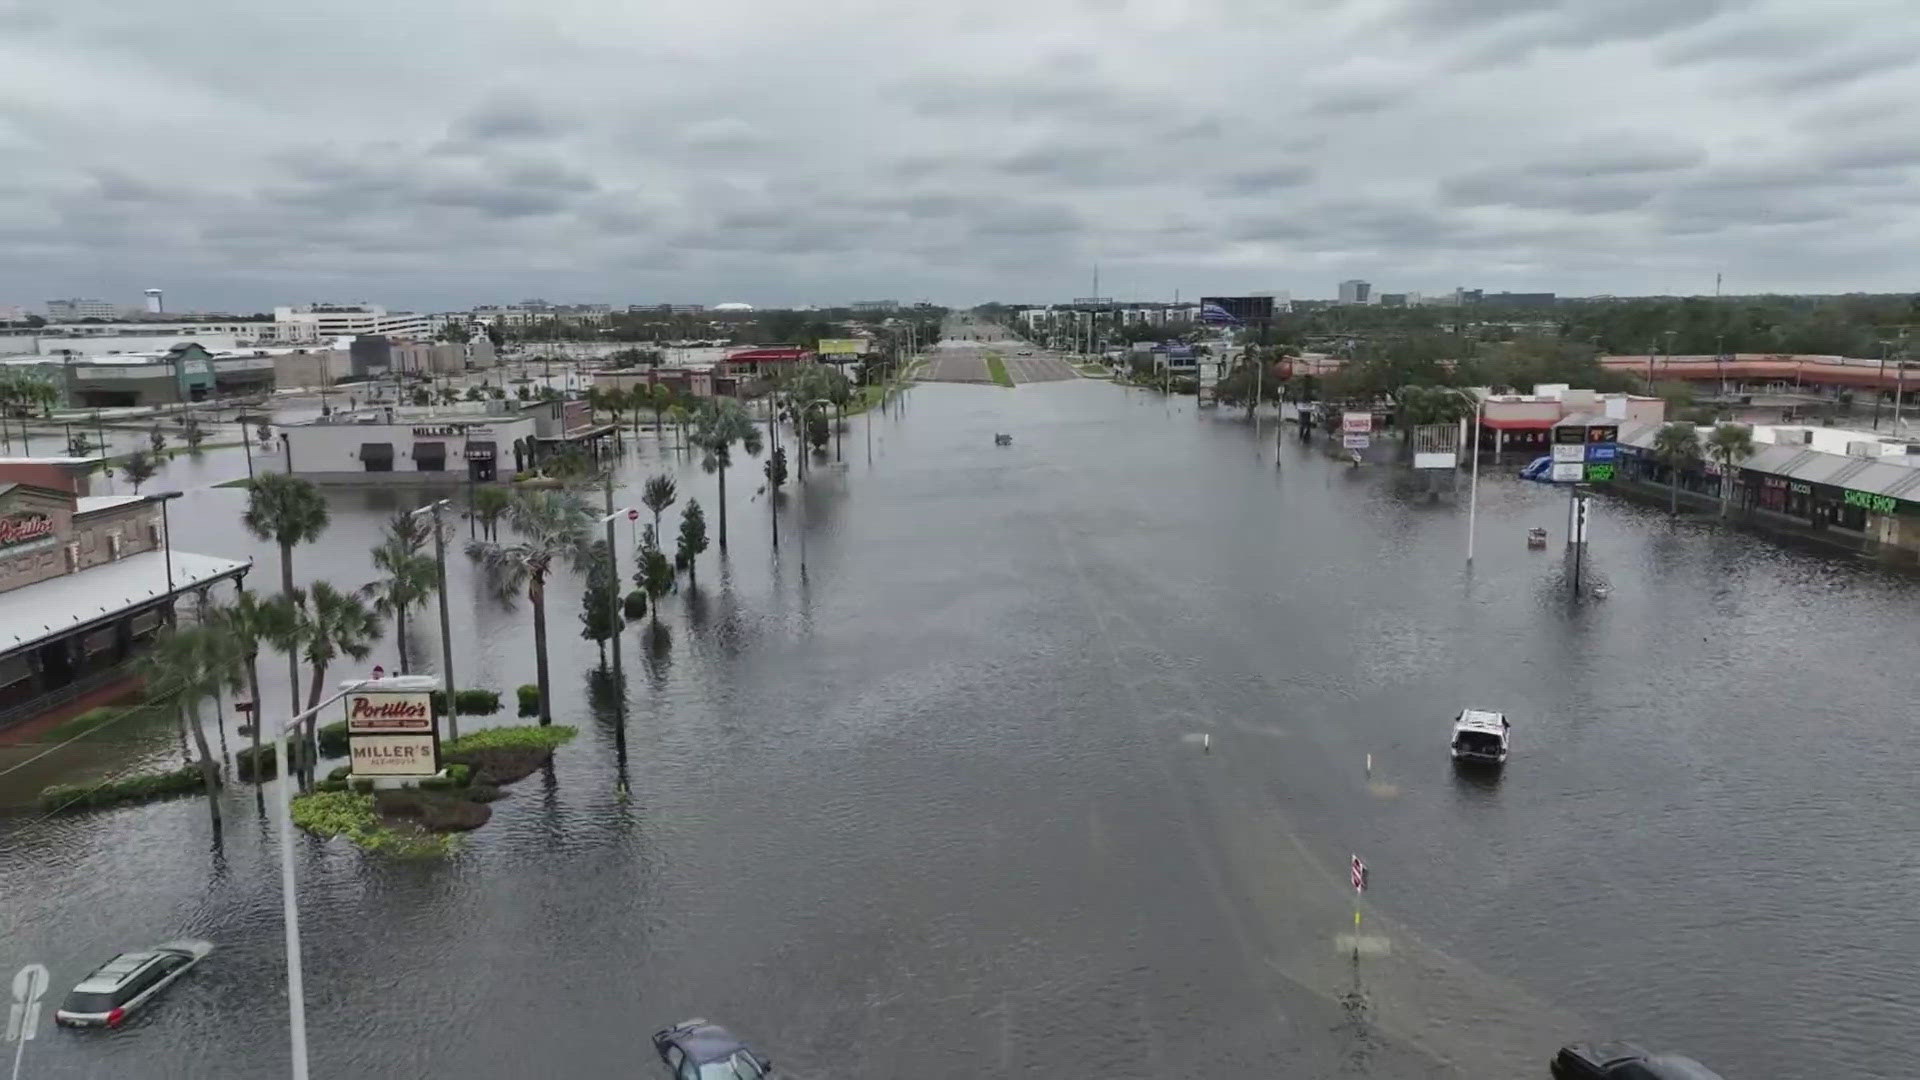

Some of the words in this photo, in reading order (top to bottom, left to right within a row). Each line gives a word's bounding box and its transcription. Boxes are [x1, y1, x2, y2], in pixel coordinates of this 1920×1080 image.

[1844, 490, 1871, 508] SMOKE
[1873, 495, 1896, 512] SHOP
[352, 697, 426, 718] Portillo's
[353, 745, 430, 758] MILLER'S
